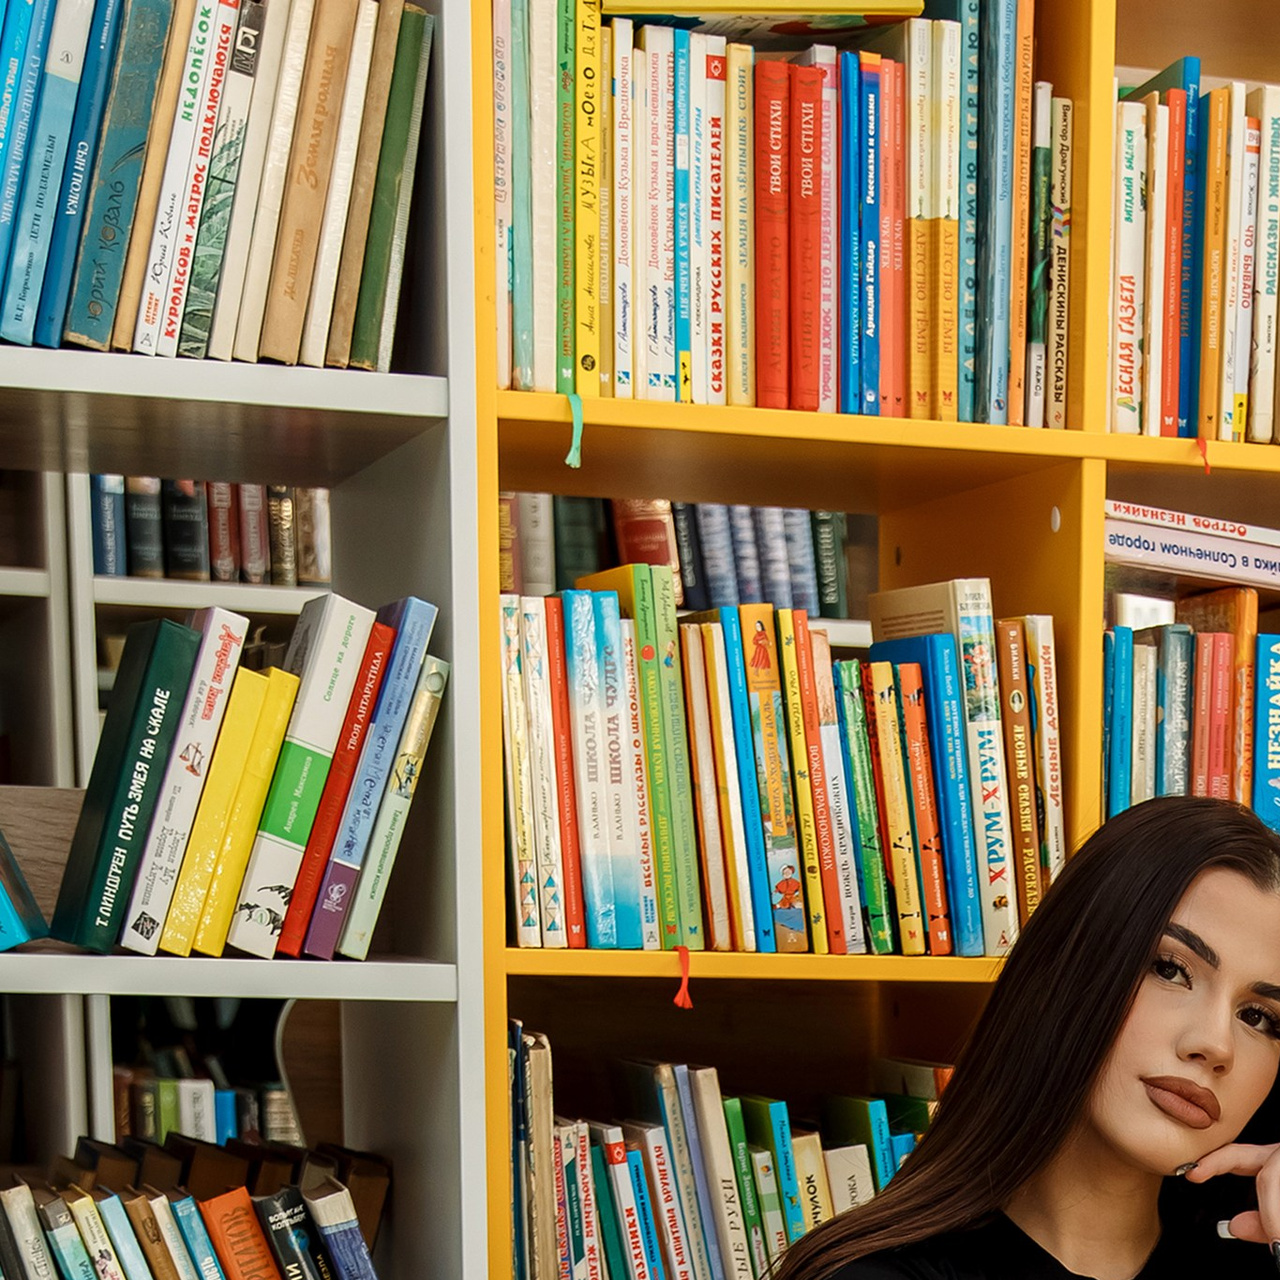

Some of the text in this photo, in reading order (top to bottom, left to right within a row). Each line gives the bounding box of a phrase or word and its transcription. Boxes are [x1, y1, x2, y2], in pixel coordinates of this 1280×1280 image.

[866, 94, 876, 134] сказки
[65, 141, 88, 214] СЫН ПОЛКА
[738, 66, 747, 267] ЗЕМЛЯ НА ЗЁРНЫШКЕ СТОИТ
[770, 100, 782, 194] ТВОИ СТИХИ
[866, 150, 876, 204] Рассказы
[1268, 117, 1280, 198] ЖИВОТНЫХ
[28, 135, 56, 243] ДЕТИ ПОДЗЕМЕЛЬЯ
[865, 241, 876, 282] Гайдар
[1241, 225, 1253, 308] ЧТО БЫВАЛО
[1266, 219, 1279, 295] РАССКАЗЫ
[865, 286, 876, 337] Аркадий
[1053, 246, 1065, 403] ДЕНИСКИНЫ РАССКАЗЫ
[1117, 276, 1135, 334] ГАЗЕТА
[1109, 532, 1156, 554] городе
[1114, 503, 1246, 537] ОСТРОВ НЕЗНАЙКИ
[1162, 541, 1236, 568] Солнечном
[1242, 554, 1248, 570] в
[323, 615, 358, 702] Солнце на дороге
[145, 688, 170, 735] СКАЛЕ
[347, 652, 383, 750] ТВОЯ АНТАРКТИДА
[1041, 645, 1060, 807] ЛЕСНЫЕ ДОМИШКИ
[139, 739, 157, 758] НА
[606, 714, 622, 784] ШКОЛА
[128, 762, 151, 801] ЗМЕЯ
[283, 756, 312, 833] Андрей Максимов
[978, 729, 1006, 885] ХРУМ-ХРУМ
[118, 805, 139, 840] ПУТЬ
[98, 847, 128, 917] ЛИНДГРЕН
[653, 1146, 675, 1202] ВРУНГЕЛЯ
[665, 1208, 687, 1264] КАПИТАНА
